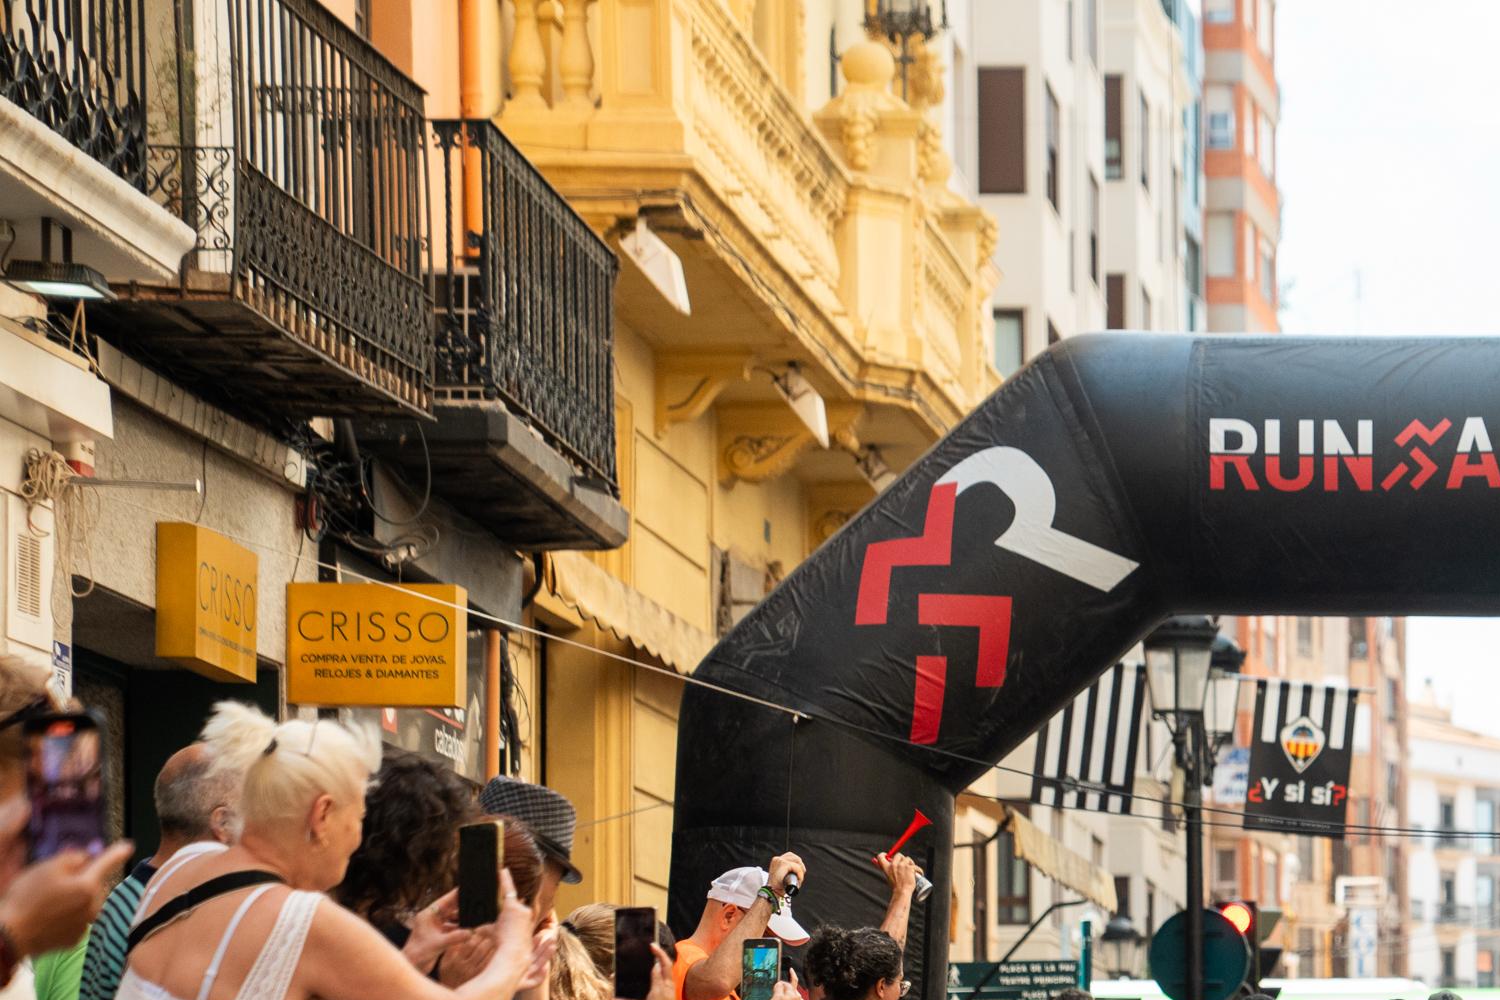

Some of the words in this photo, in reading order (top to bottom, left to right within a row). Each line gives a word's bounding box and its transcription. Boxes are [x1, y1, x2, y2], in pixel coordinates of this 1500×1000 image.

[1208, 417, 1373, 492] RUN
[199, 560, 255, 632] CRISSO
[297, 610, 449, 643] CRISSO
[300, 653, 348, 665] COMPRA
[350, 653, 388, 665] VENTA
[392, 654, 407, 664] DE
[314, 668, 362, 679] RELOJES
[365, 668, 374, 679] &
[376, 669, 440, 680] DIAMANTES
